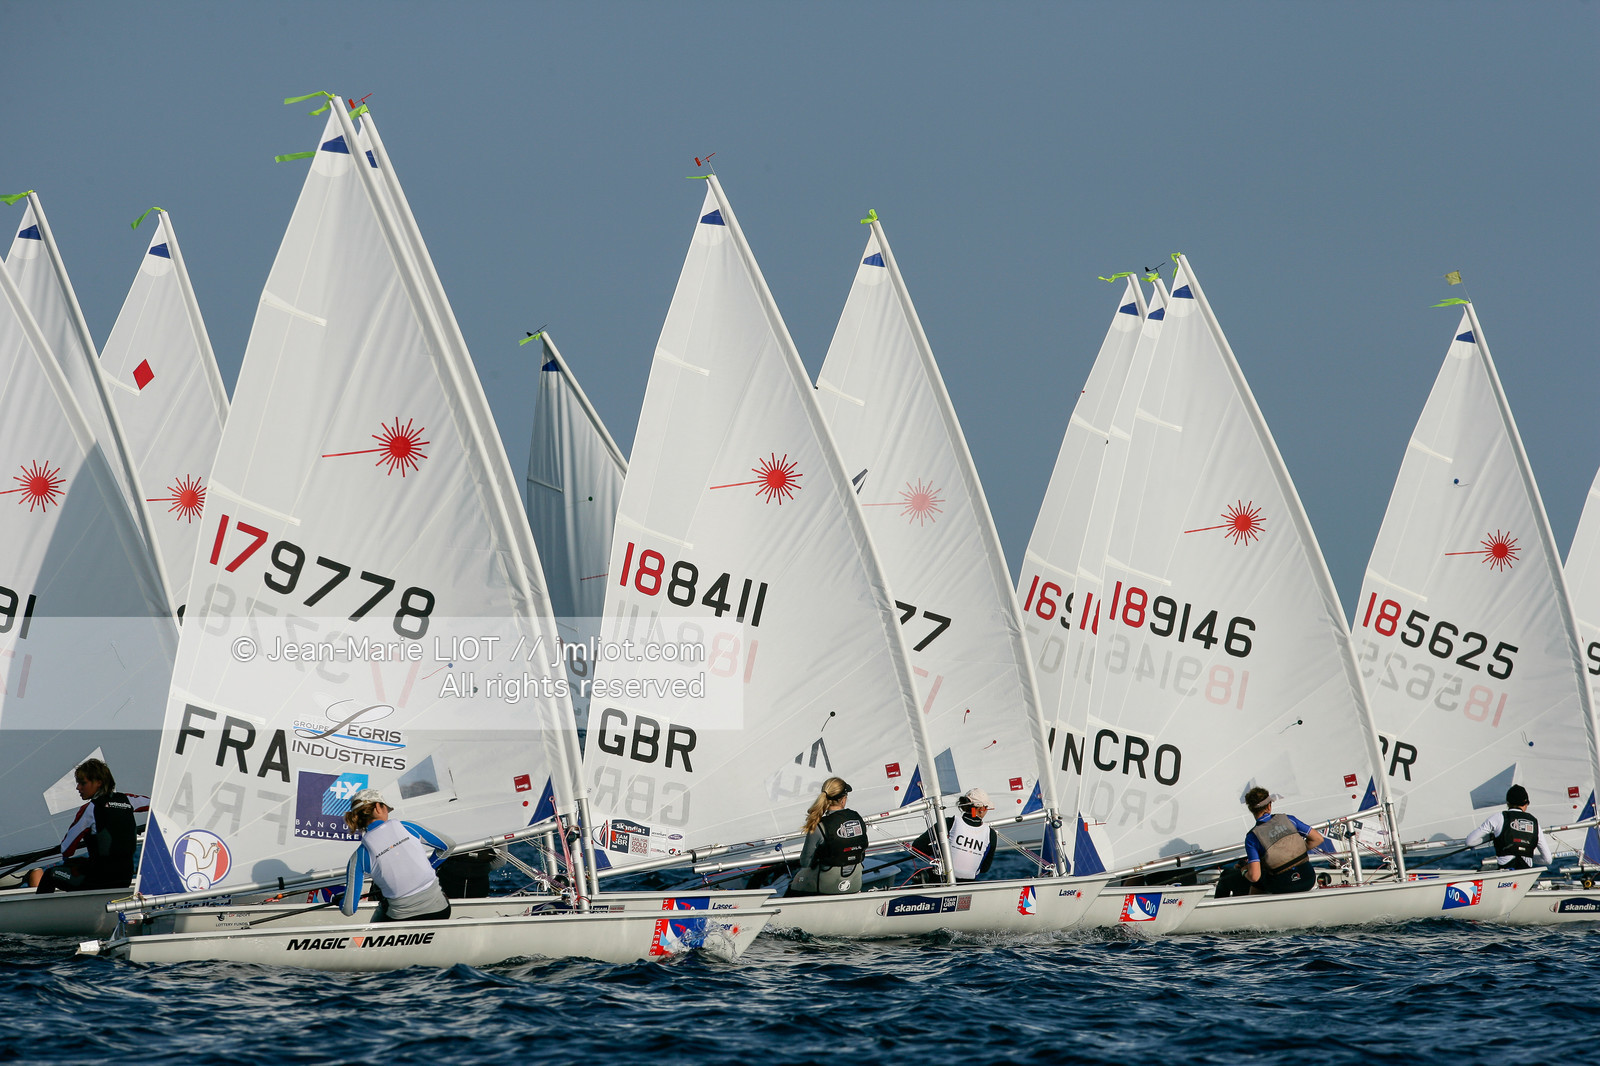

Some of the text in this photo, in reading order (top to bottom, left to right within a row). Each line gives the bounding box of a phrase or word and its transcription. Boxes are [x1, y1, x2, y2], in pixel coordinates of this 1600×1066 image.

[210, 514, 435, 640] 179778
[620, 542, 768, 627] 188411
[1109, 581, 1256, 658] 189146
[1362, 592, 1519, 680] 185625
[293, 719, 330, 732] GROUPE
[175, 703, 291, 783] FRA
[597, 707, 697, 773] GBR
[291, 739, 406, 771] INDUSTRIES
[1093, 728, 1182, 787] CRO
[295, 818, 359, 831] BANQU
[295, 828, 360, 840] POPULAIRE
[956, 834, 984, 852] CHN
[1059, 888, 1077, 897] Laser
[1498, 881, 1513, 889] Laser
[712, 902, 732, 910] Laser
[1162, 897, 1179, 905] Laser
[286, 932, 436, 951] MAGIC MARINE
